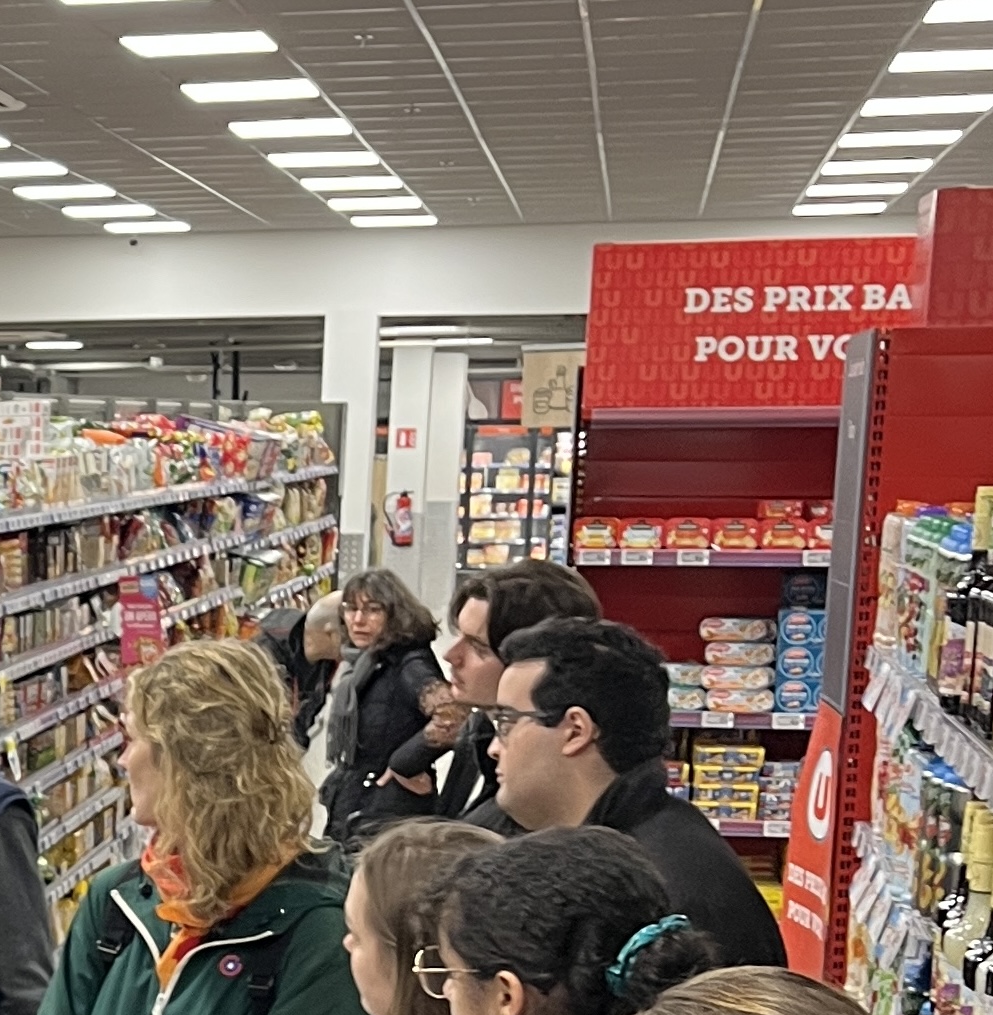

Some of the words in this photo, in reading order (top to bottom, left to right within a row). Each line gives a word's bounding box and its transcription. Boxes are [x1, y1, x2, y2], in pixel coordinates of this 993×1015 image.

[683, 286, 754, 314] DES
[763, 285, 853, 312] PRIX
[861, 283, 913, 311] BA
[694, 335, 798, 363] POUR
